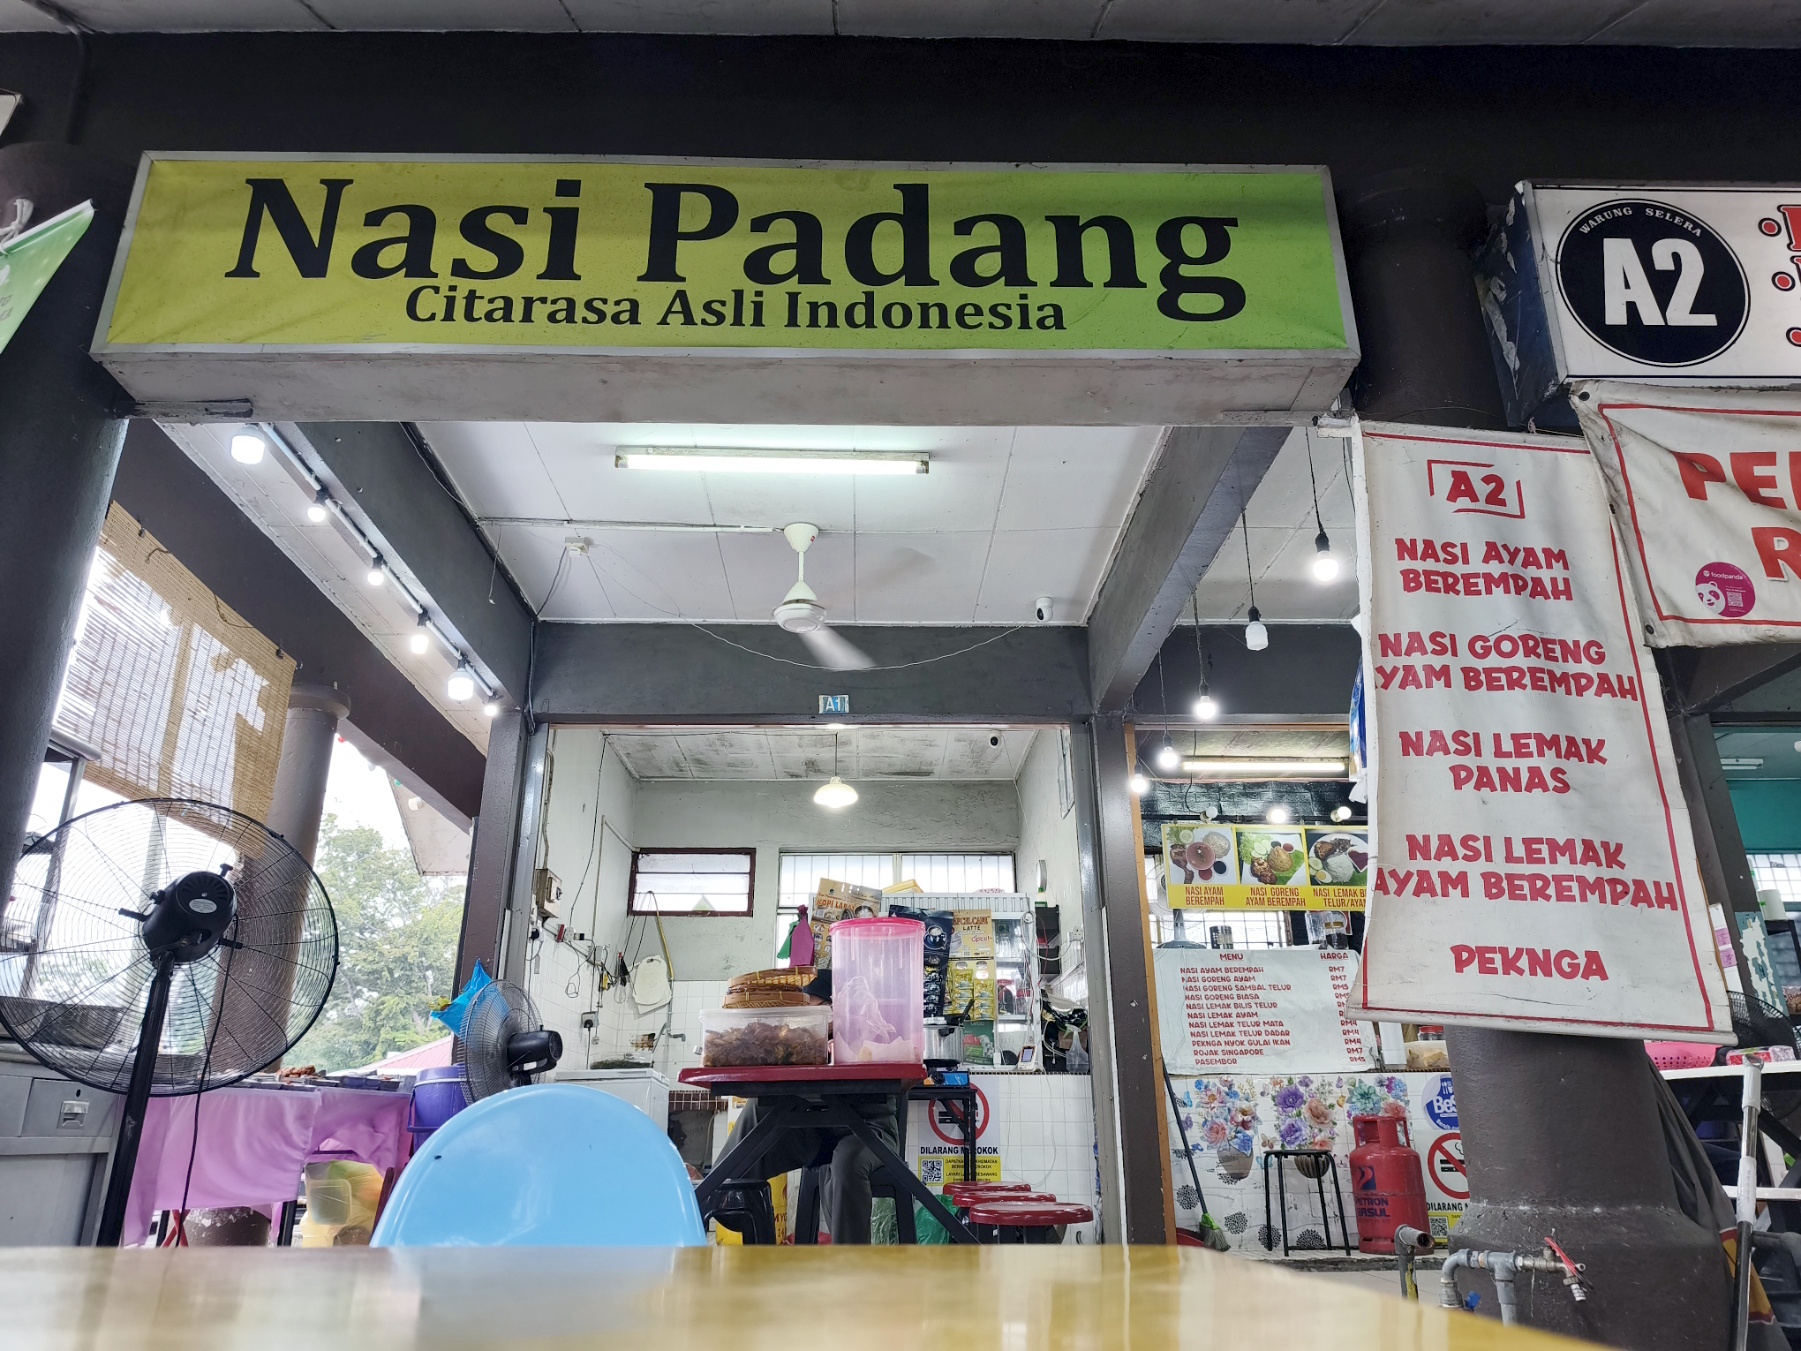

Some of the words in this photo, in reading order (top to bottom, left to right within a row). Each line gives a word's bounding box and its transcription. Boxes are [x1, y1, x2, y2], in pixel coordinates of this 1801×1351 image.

[1578, 206, 1634, 235] WARUNG
[1644, 207, 1703, 238] SELERA
[224, 178, 582, 281] Nasi
[637, 182, 1247, 323] Padang
[1603, 237, 1718, 327] A2
[405, 285, 642, 326] Citarasa
[656, 289, 766, 328] Asli
[783, 289, 1068, 331] Indonesia
[1669, 451, 1801, 512] PE
[1446, 470, 1507, 508] A2
[1395, 538, 1470, 566] NASI
[1482, 541, 1570, 571] AYAM
[1711, 571, 1744, 580] foodpanda
[1400, 568, 1573, 601] BEREMPAH
[1378, 631, 1459, 658] NASI
[1467, 633, 1606, 665] GORENG
[1374, 664, 1452, 690] YAM
[1460, 666, 1639, 702] BEREMPAH
[825, 696, 841, 712] A1
[1399, 730, 1482, 757] NASI
[1493, 732, 1608, 765] LEMAK
[1448, 764, 1571, 794] PANAS
[1405, 834, 1494, 863] NASI
[1504, 836, 1627, 870] LEMAK
[1185, 886, 1202, 896] NASI
[1203, 886, 1224, 896] AYAM
[1250, 886, 1267, 896] NASI
[1270, 887, 1300, 897] GORENG
[1313, 888, 1330, 898] NASI
[1333, 888, 1359, 898] LEMAK
[1374, 868, 1470, 898] AYAM
[1480, 871, 1679, 911] BEREMPAH
[1186, 896, 1225, 906] BEREMPAH
[1246, 896, 1266, 907] AYAM
[1267, 896, 1306, 907] BEREMPAH
[1219, 953, 1244, 961] MENU
[1320, 952, 1349, 960] HARGA
[1450, 943, 1609, 982] PEKNGA
[1180, 966, 1198, 974] NASI
[1200, 966, 1223, 974] AYAM
[1224, 966, 1264, 974] BEREMPAH
[1201, 975, 1231, 983] GORENG
[1203, 984, 1233, 992] GORENG
[1204, 993, 1235, 1001] GORENG
[1206, 1002, 1232, 1010] LEMAK
[1233, 1002, 1252, 1010] BILIS
[1210, 1030, 1236, 1038] LEMAK
[1224, 1039, 1246, 1047] NYOK
[1247, 1039, 1271, 1047] GULAI
[1195, 1058, 1238, 1066] PASEMBOR
[920, 1146, 959, 1155] DILARANG
